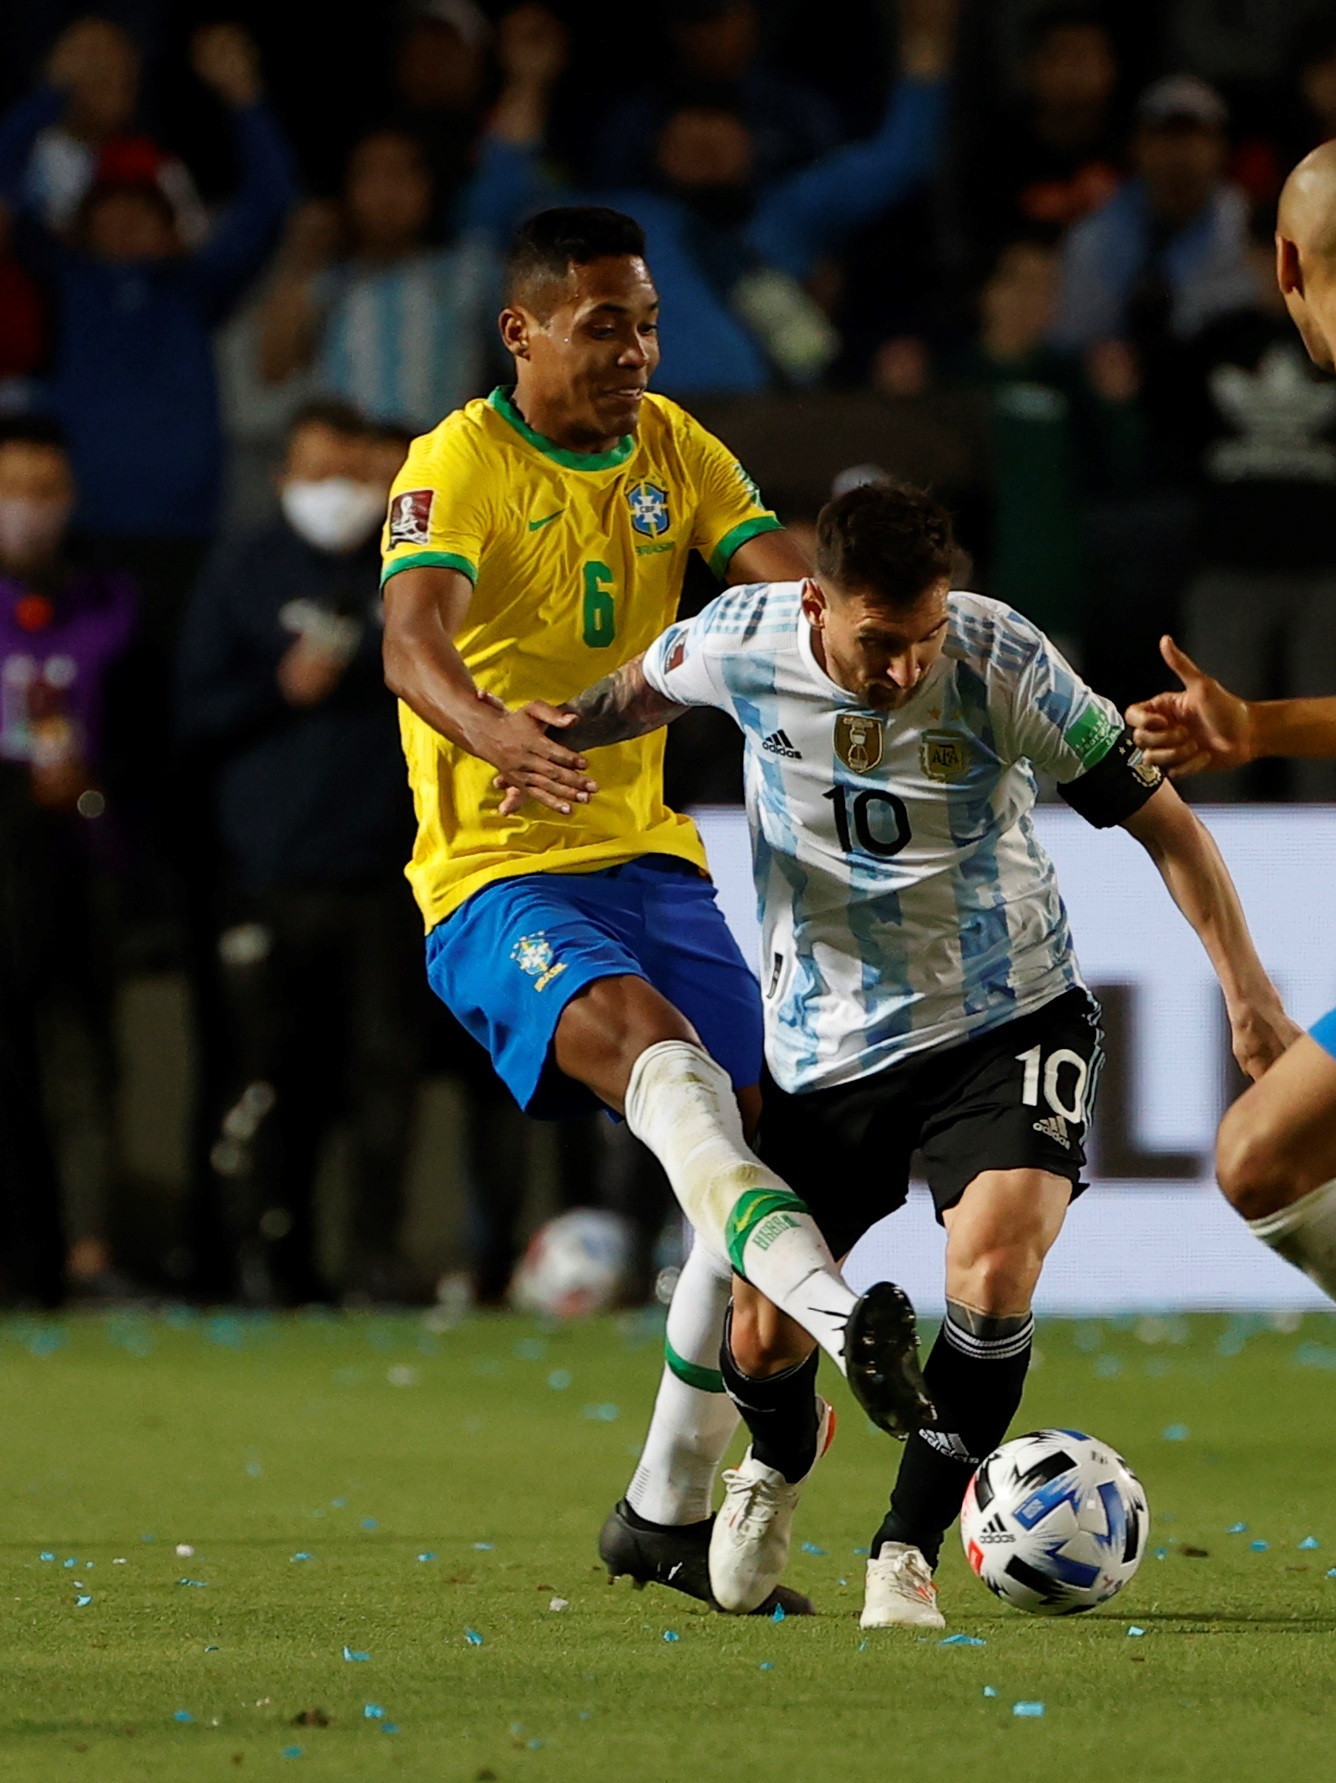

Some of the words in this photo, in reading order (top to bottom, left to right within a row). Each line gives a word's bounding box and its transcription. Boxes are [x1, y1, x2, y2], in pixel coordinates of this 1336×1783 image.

[582, 560, 615, 648] 6
[761, 740, 803, 760] adidas
[931, 743, 959, 766] AFA
[821, 784, 912, 856] 10
[1014, 1043, 1088, 1124] 10
[1032, 1121, 1071, 1150] adidas
[918, 1428, 980, 1464] adidas
